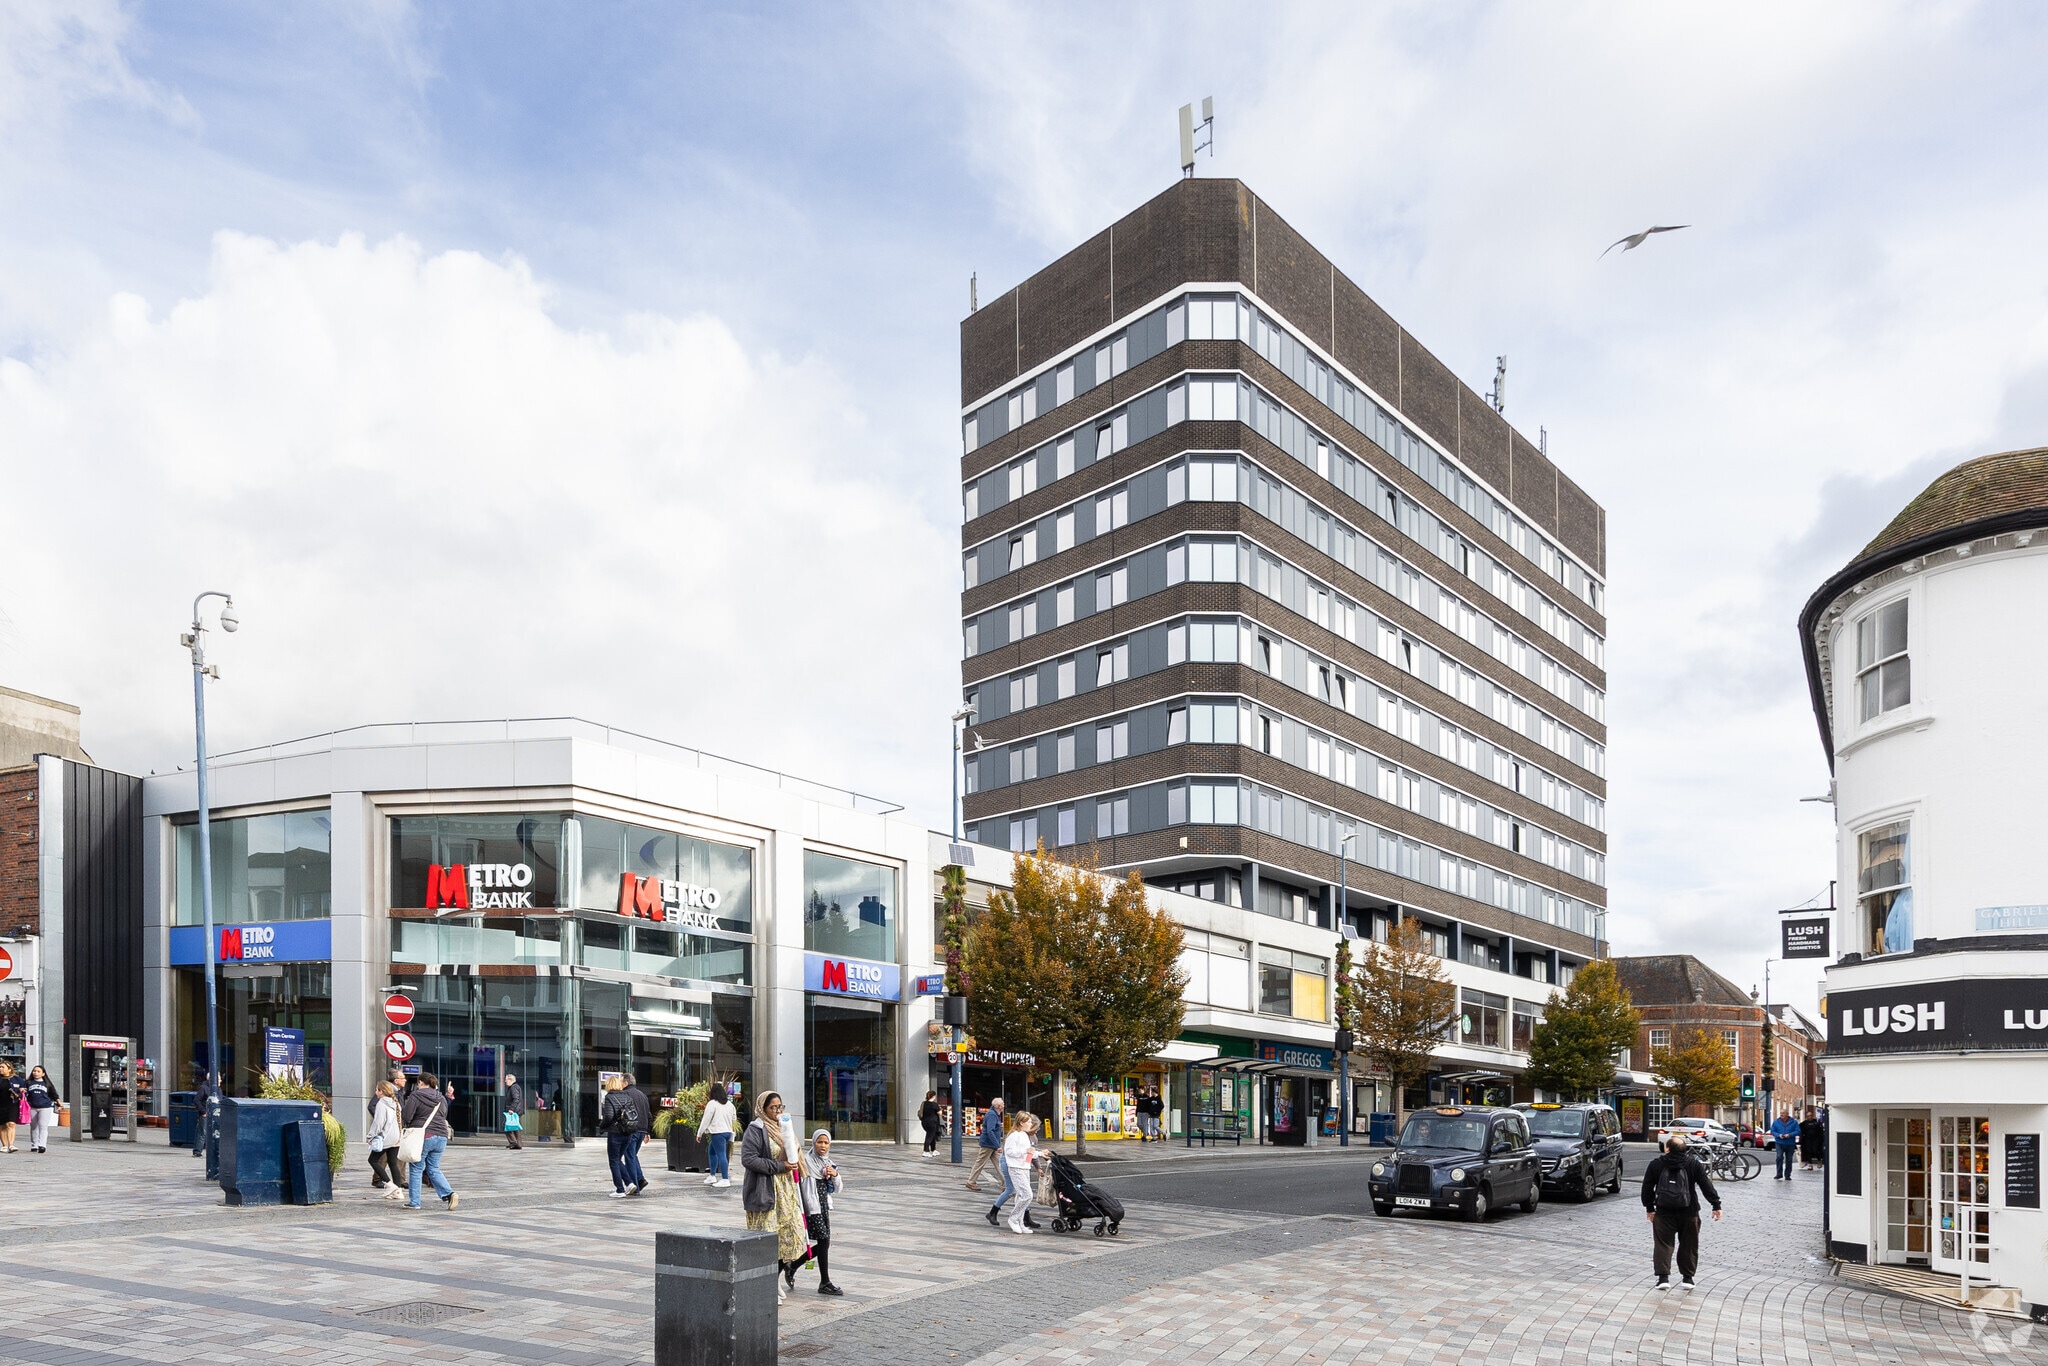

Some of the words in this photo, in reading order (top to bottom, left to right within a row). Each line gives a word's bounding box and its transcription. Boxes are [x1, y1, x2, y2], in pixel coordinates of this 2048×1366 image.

[425, 863, 534, 909] METRO
[472, 891, 534, 909] BANK
[621, 871, 722, 922] METRO
[666, 906, 722, 931] BANK
[2000, 917, 2034, 928] HILL
[1787, 926, 1824, 936] LUSH
[220, 926, 275, 960] METRO
[243, 945, 275, 959] BANK
[822, 959, 882, 992] METRO
[917, 978, 941, 992] METRO
[848, 981, 882, 996] BANK
[1842, 1001, 1946, 1037] LUSH
[2003, 1009, 2048, 1030] LU
[1283, 1050, 1322, 1068] GREGGS
